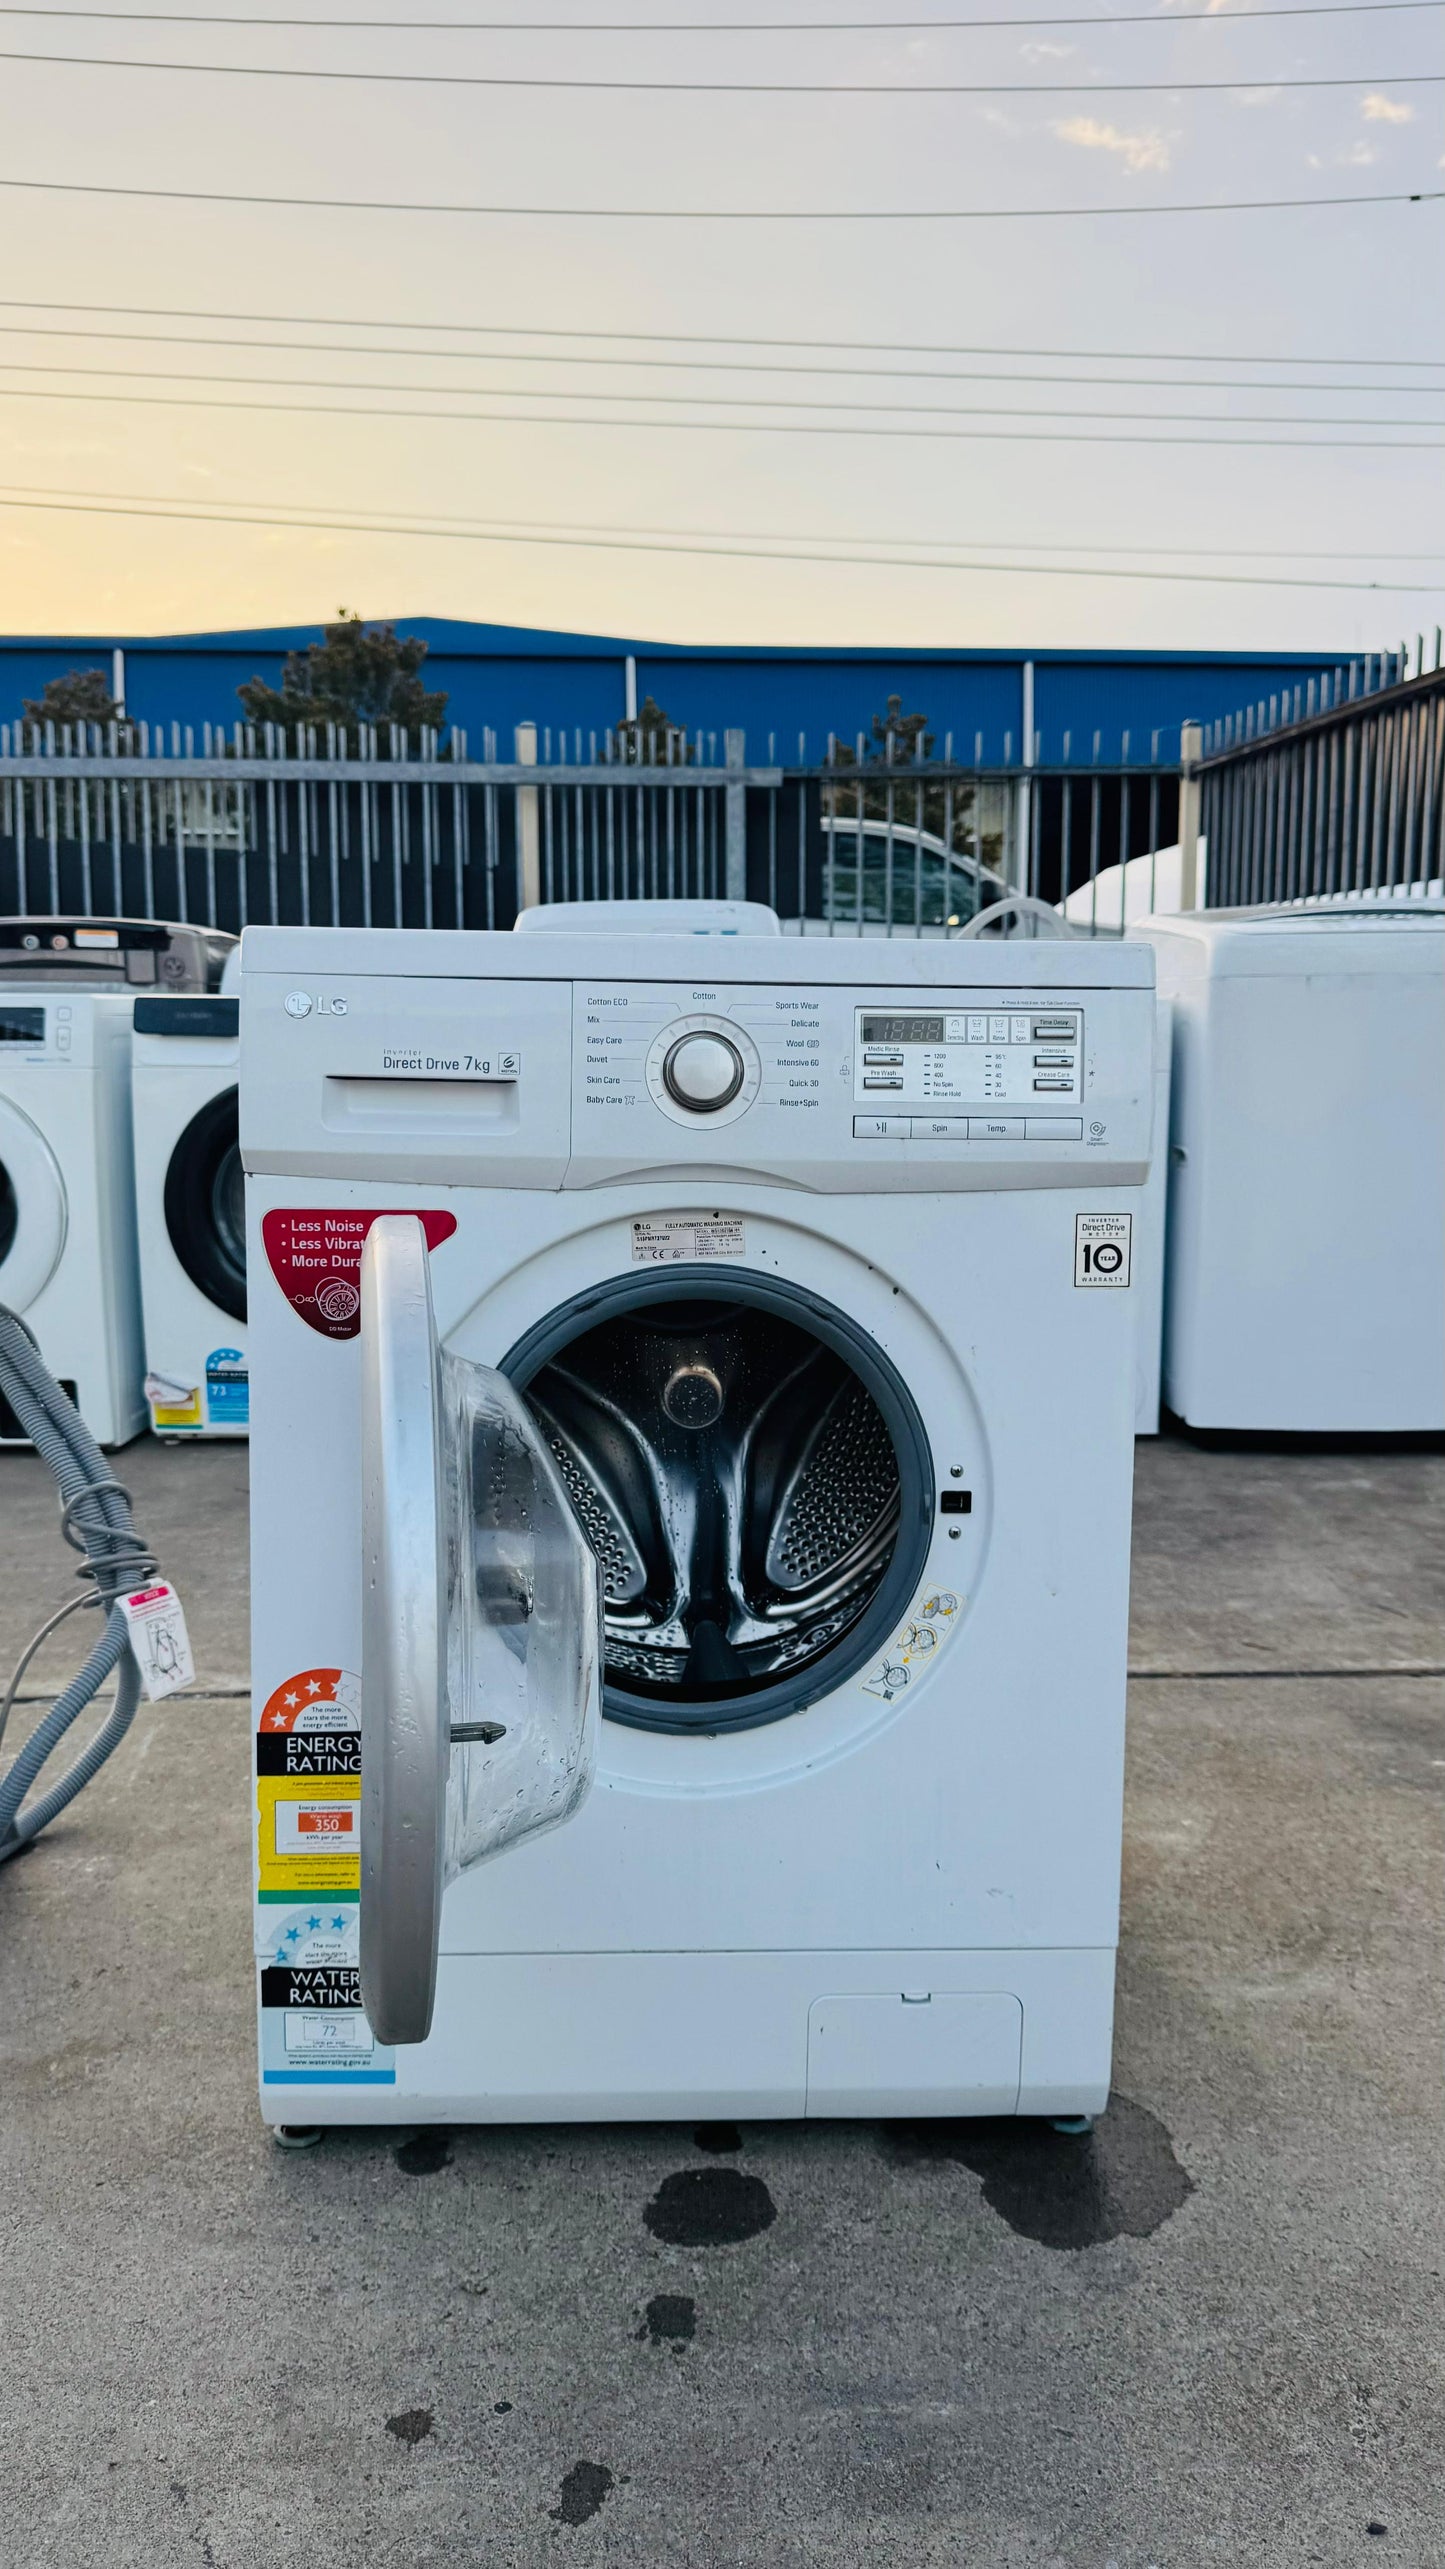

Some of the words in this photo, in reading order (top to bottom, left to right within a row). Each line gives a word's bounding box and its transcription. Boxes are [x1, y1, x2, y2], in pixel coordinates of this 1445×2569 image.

[692, 992, 716, 1000] Cotton
[316, 996, 348, 1016] LG
[587, 998, 612, 1006] Cotton
[613, 998, 628, 1006] ECO
[776, 1001, 799, 1010] Sports
[791, 1019, 820, 1027] Delicate
[587, 1036, 604, 1045] Easy
[383, 1056, 422, 1070] Direct
[426, 1057, 460, 1070] Drive
[586, 1055, 608, 1063] Duvet
[777, 1059, 809, 1067] Intensive
[586, 1076, 602, 1084] Skin
[604, 1076, 621, 1084] Care
[586, 1095, 604, 1104] Baby
[605, 1096, 623, 1104] Care
[932, 1124, 948, 1132] Spin
[291, 1220, 321, 1232] Less
[325, 1220, 364, 1232] Noise
[1082, 1223, 1104, 1231] Direct
[1106, 1223, 1126, 1231] Drive
[291, 1237, 321, 1249] Less
[292, 1255, 328, 1267] More
[1083, 1243, 1123, 1273] 10
[286, 1737, 361, 1753] ENERGY
[315, 1819, 340, 1832] 350
[291, 1971, 360, 1987] WATER
[323, 2025, 337, 2037] 72
